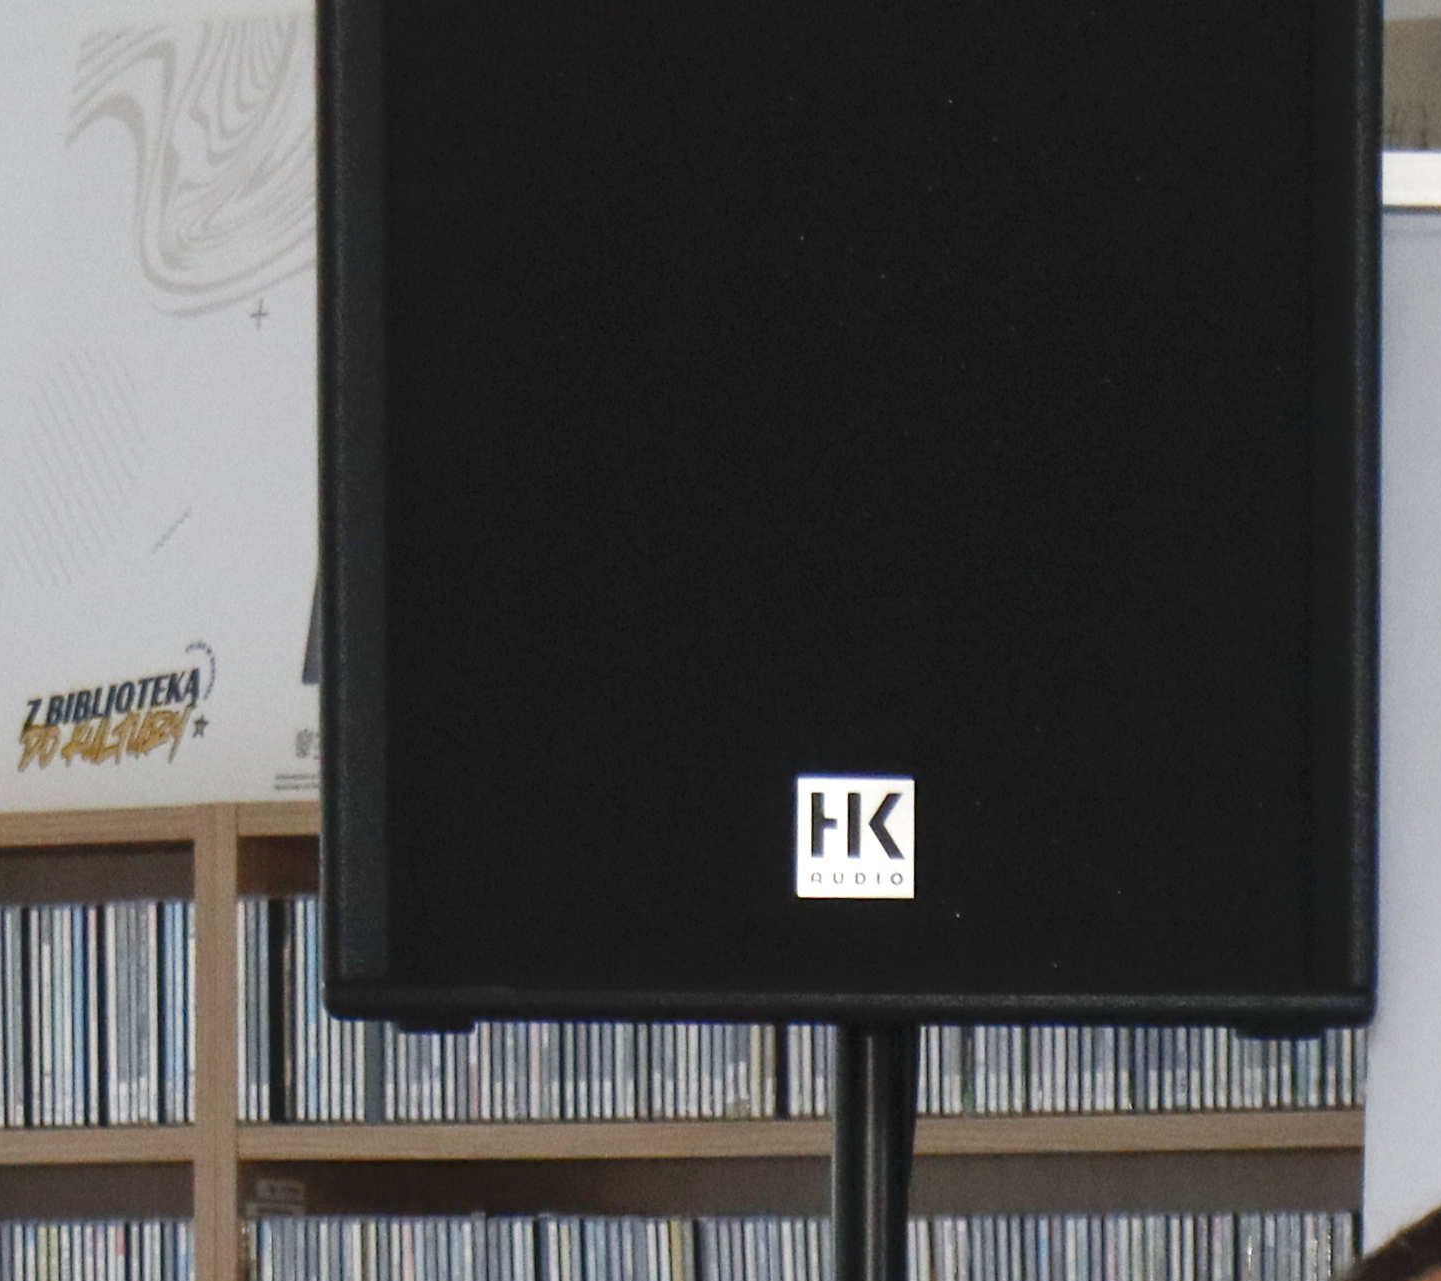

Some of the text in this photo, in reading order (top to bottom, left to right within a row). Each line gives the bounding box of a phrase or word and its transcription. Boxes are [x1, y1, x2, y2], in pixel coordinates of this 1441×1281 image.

[20, 698, 43, 738] Z
[810, 791, 906, 861] HK
[810, 871, 904, 886] AUDIO
